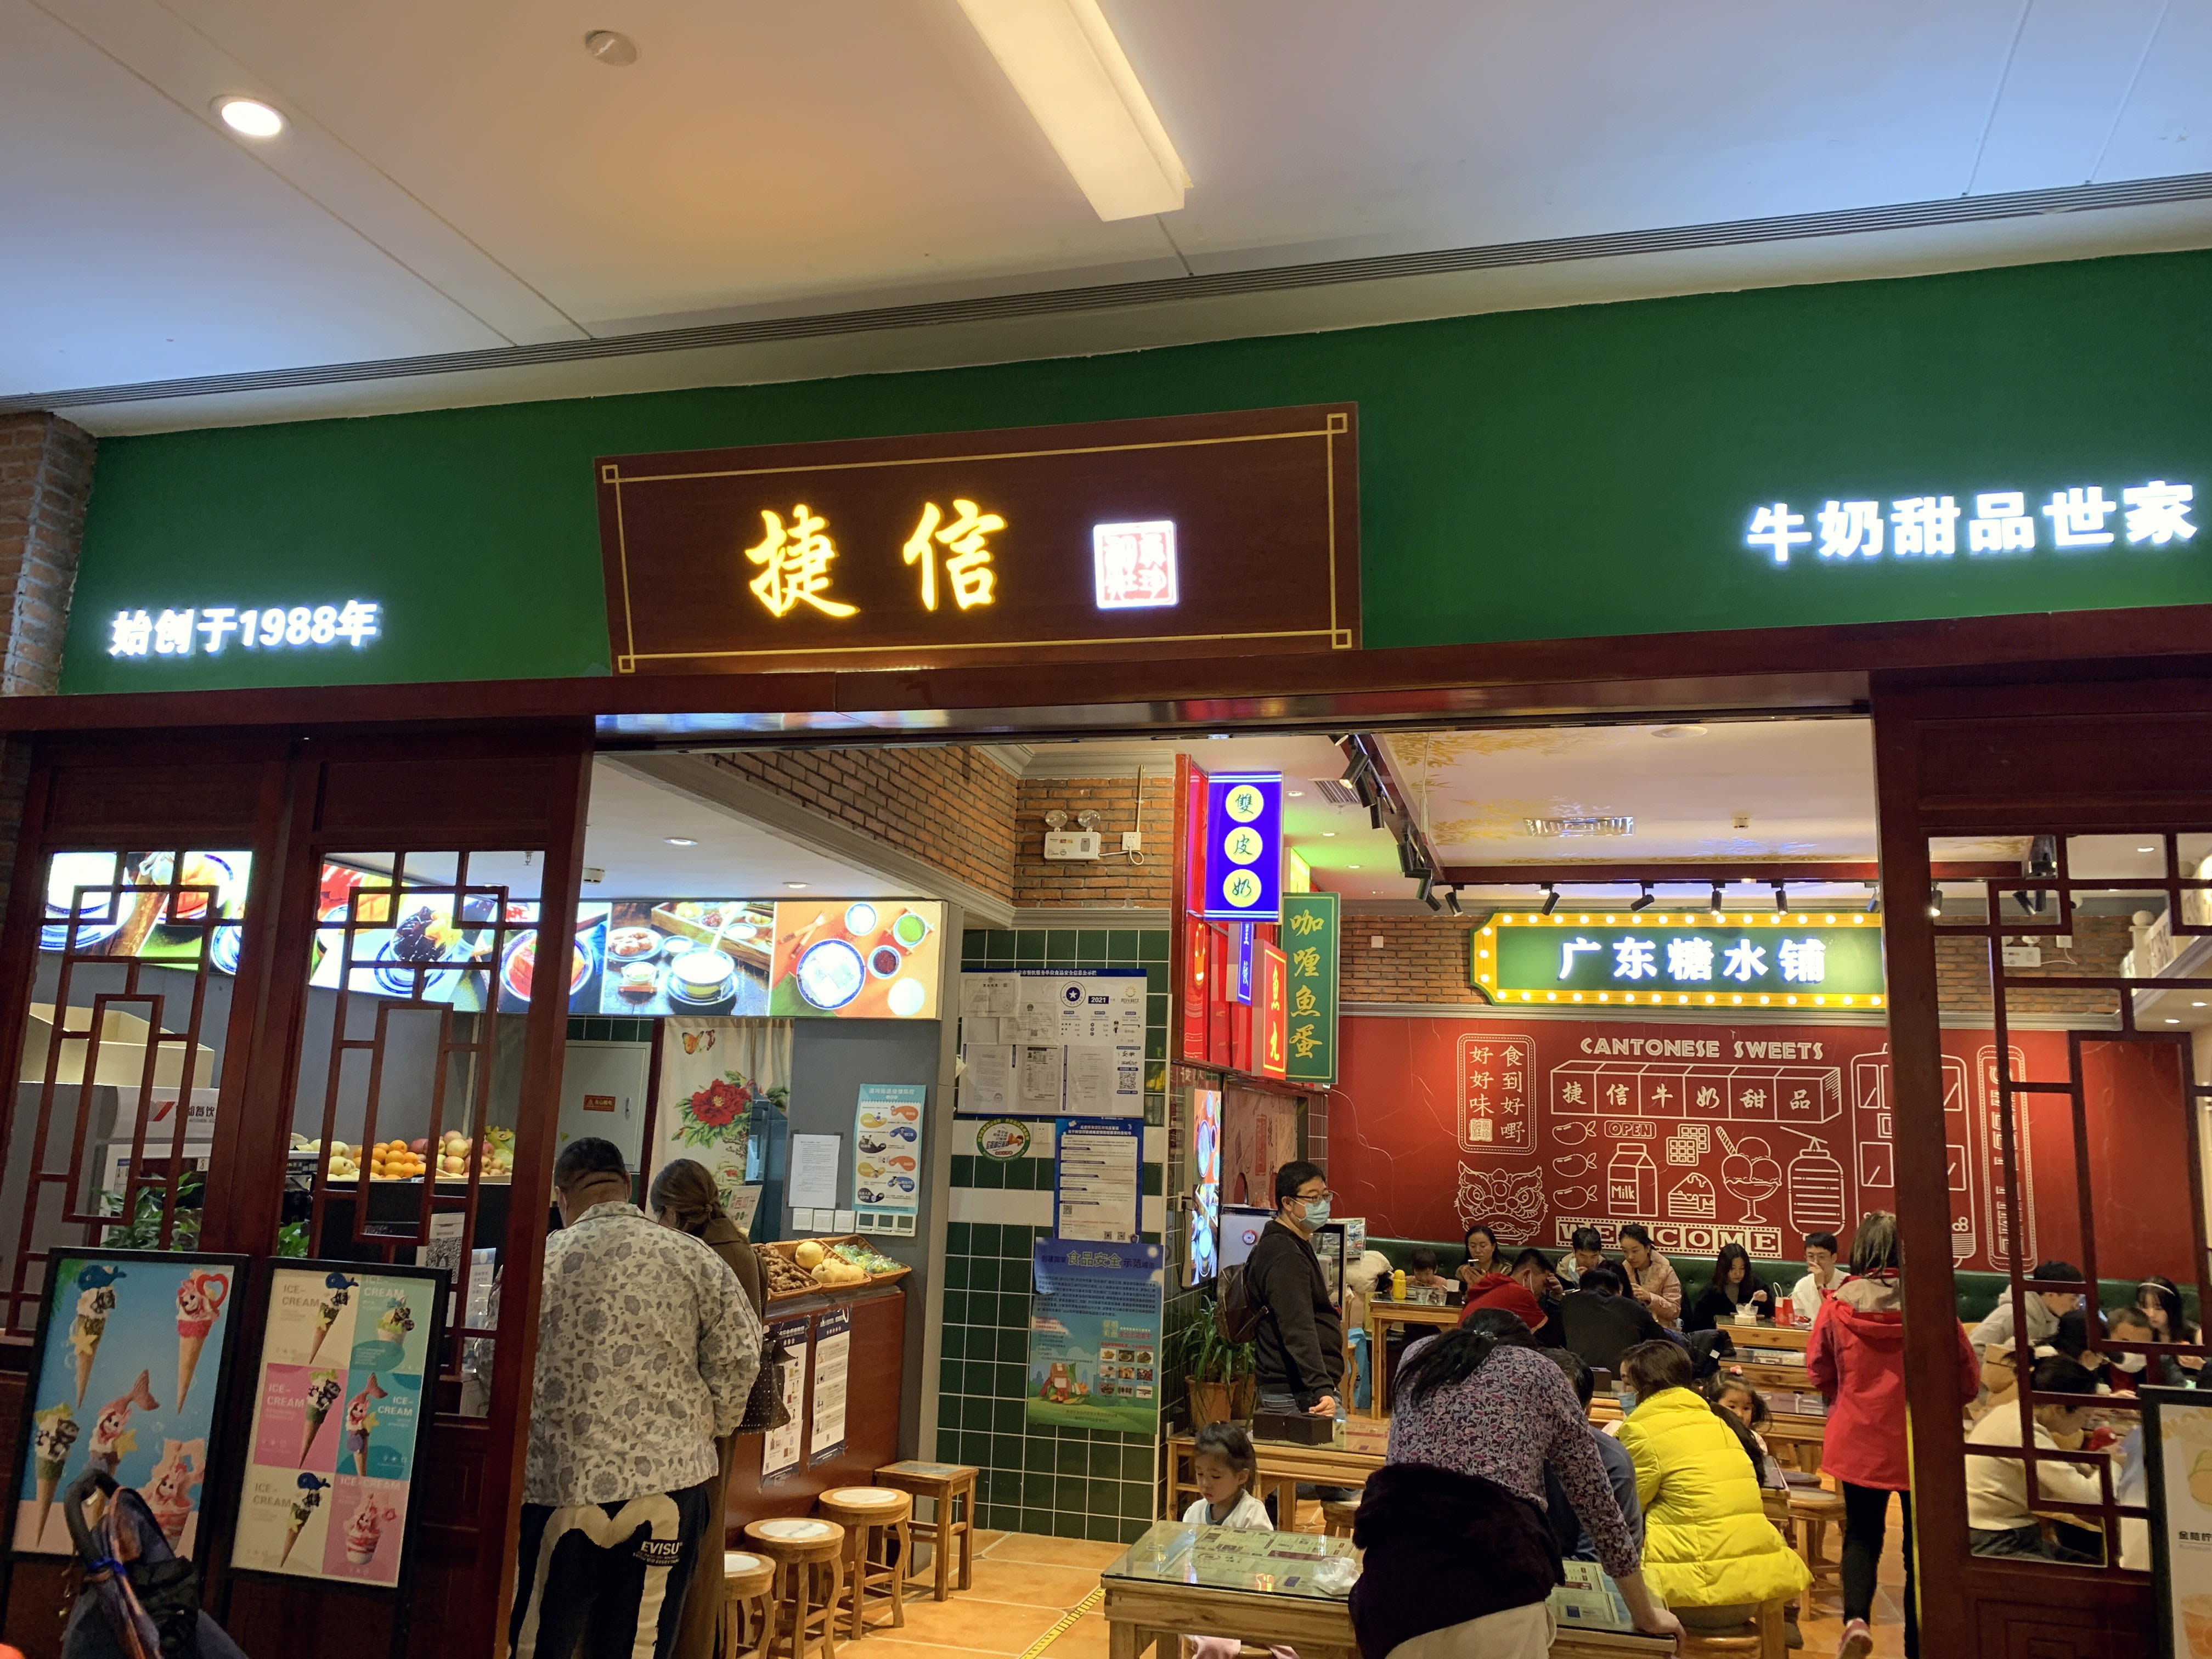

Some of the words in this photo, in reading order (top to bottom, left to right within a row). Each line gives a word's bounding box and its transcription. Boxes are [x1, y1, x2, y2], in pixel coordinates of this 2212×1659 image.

[1747, 480, 2198, 562] 牛奶甜品世家
[744, 499, 1006, 618] 捷信
[109, 599, 379, 657] 始创于1988年
[1232, 793, 1254, 898] 雙皮奶
[1558, 936, 1827, 983] 广东糖水铺
[1581, 1037, 1720, 1058] CANTONESE
[1734, 1041, 1824, 1060] SWEETS
[1469, 1045, 1494, 1117] 好好味
[1561, 1081, 1812, 1111] 捷信牛奶甜品
[1609, 1121, 1653, 1137] OPEN
[1611, 1184, 1635, 1200] Milk
[1559, 1223, 1777, 1251] WECOME
[281, 1296, 320, 1307] CREAM
[364, 1287, 405, 1298] CREAM
[267, 1396, 304, 1408] CREAM
[377, 1407, 413, 1417] CREAM
[253, 1495, 292, 1508] CREAM
[640, 1541, 680, 1555] EVISU
